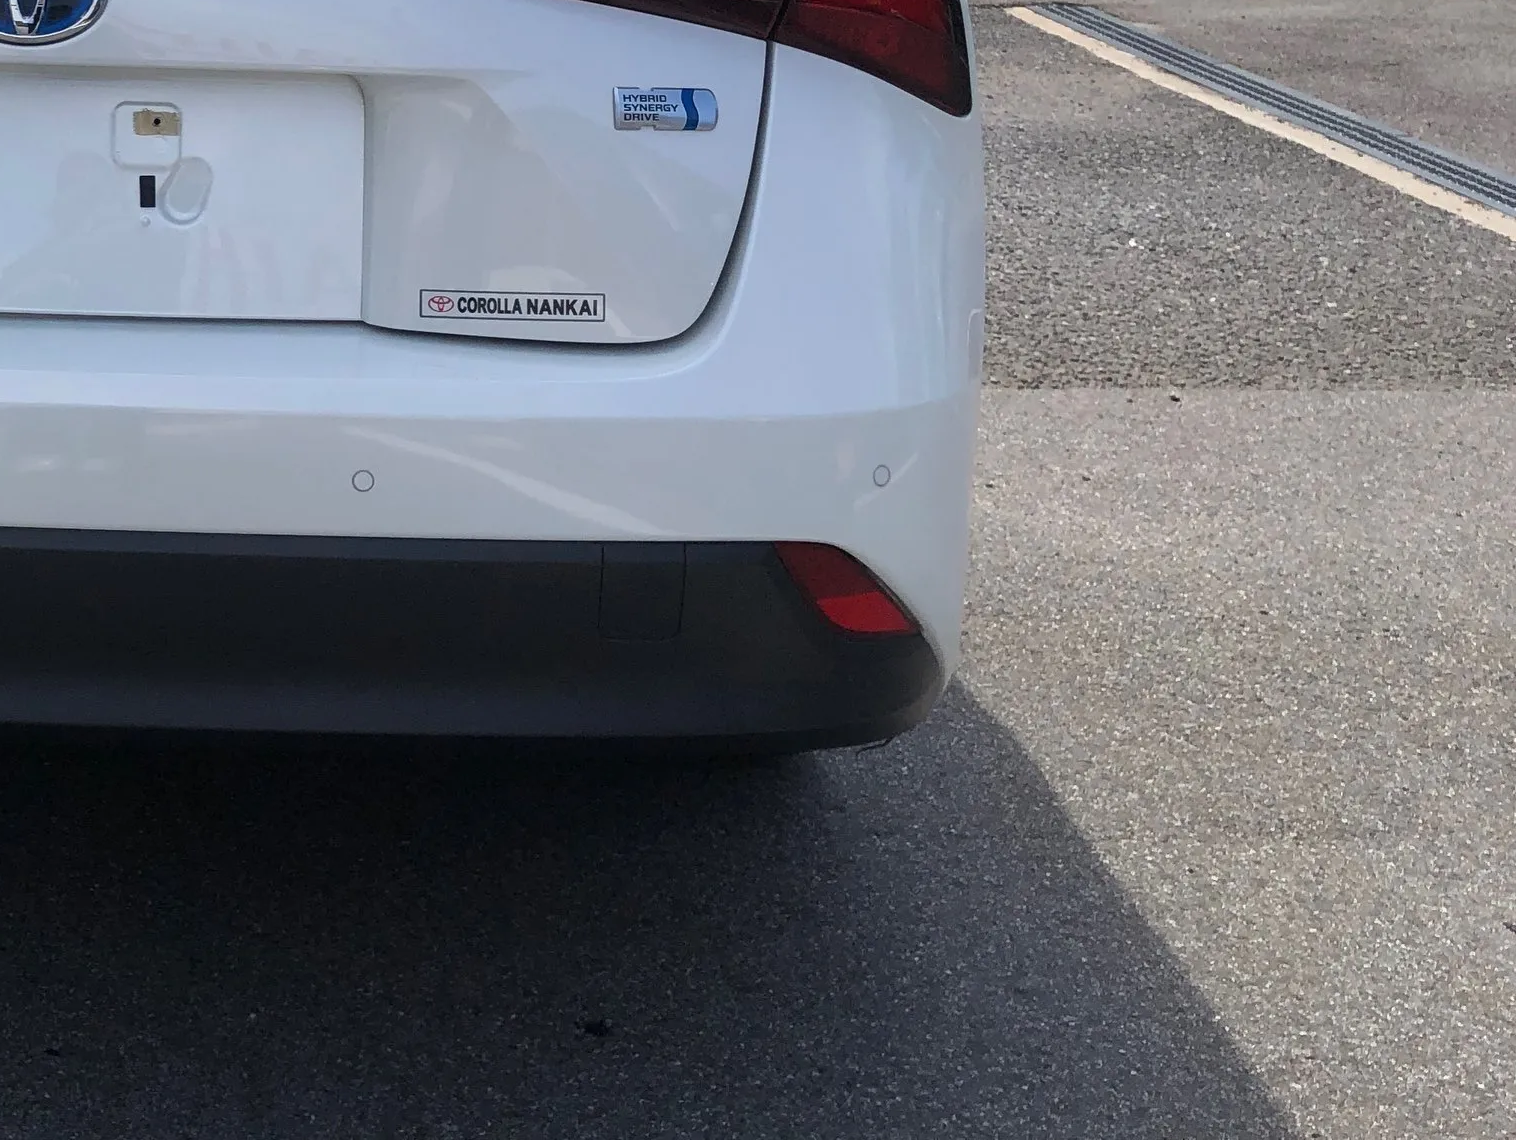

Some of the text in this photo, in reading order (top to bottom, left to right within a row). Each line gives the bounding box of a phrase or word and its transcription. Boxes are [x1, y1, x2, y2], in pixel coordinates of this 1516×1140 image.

[623, 94, 667, 103] HYBRID
[624, 103, 679, 112] SYNERGY
[624, 113, 660, 121] DRIVE
[457, 297, 598, 316] COROLLA NANKAI
